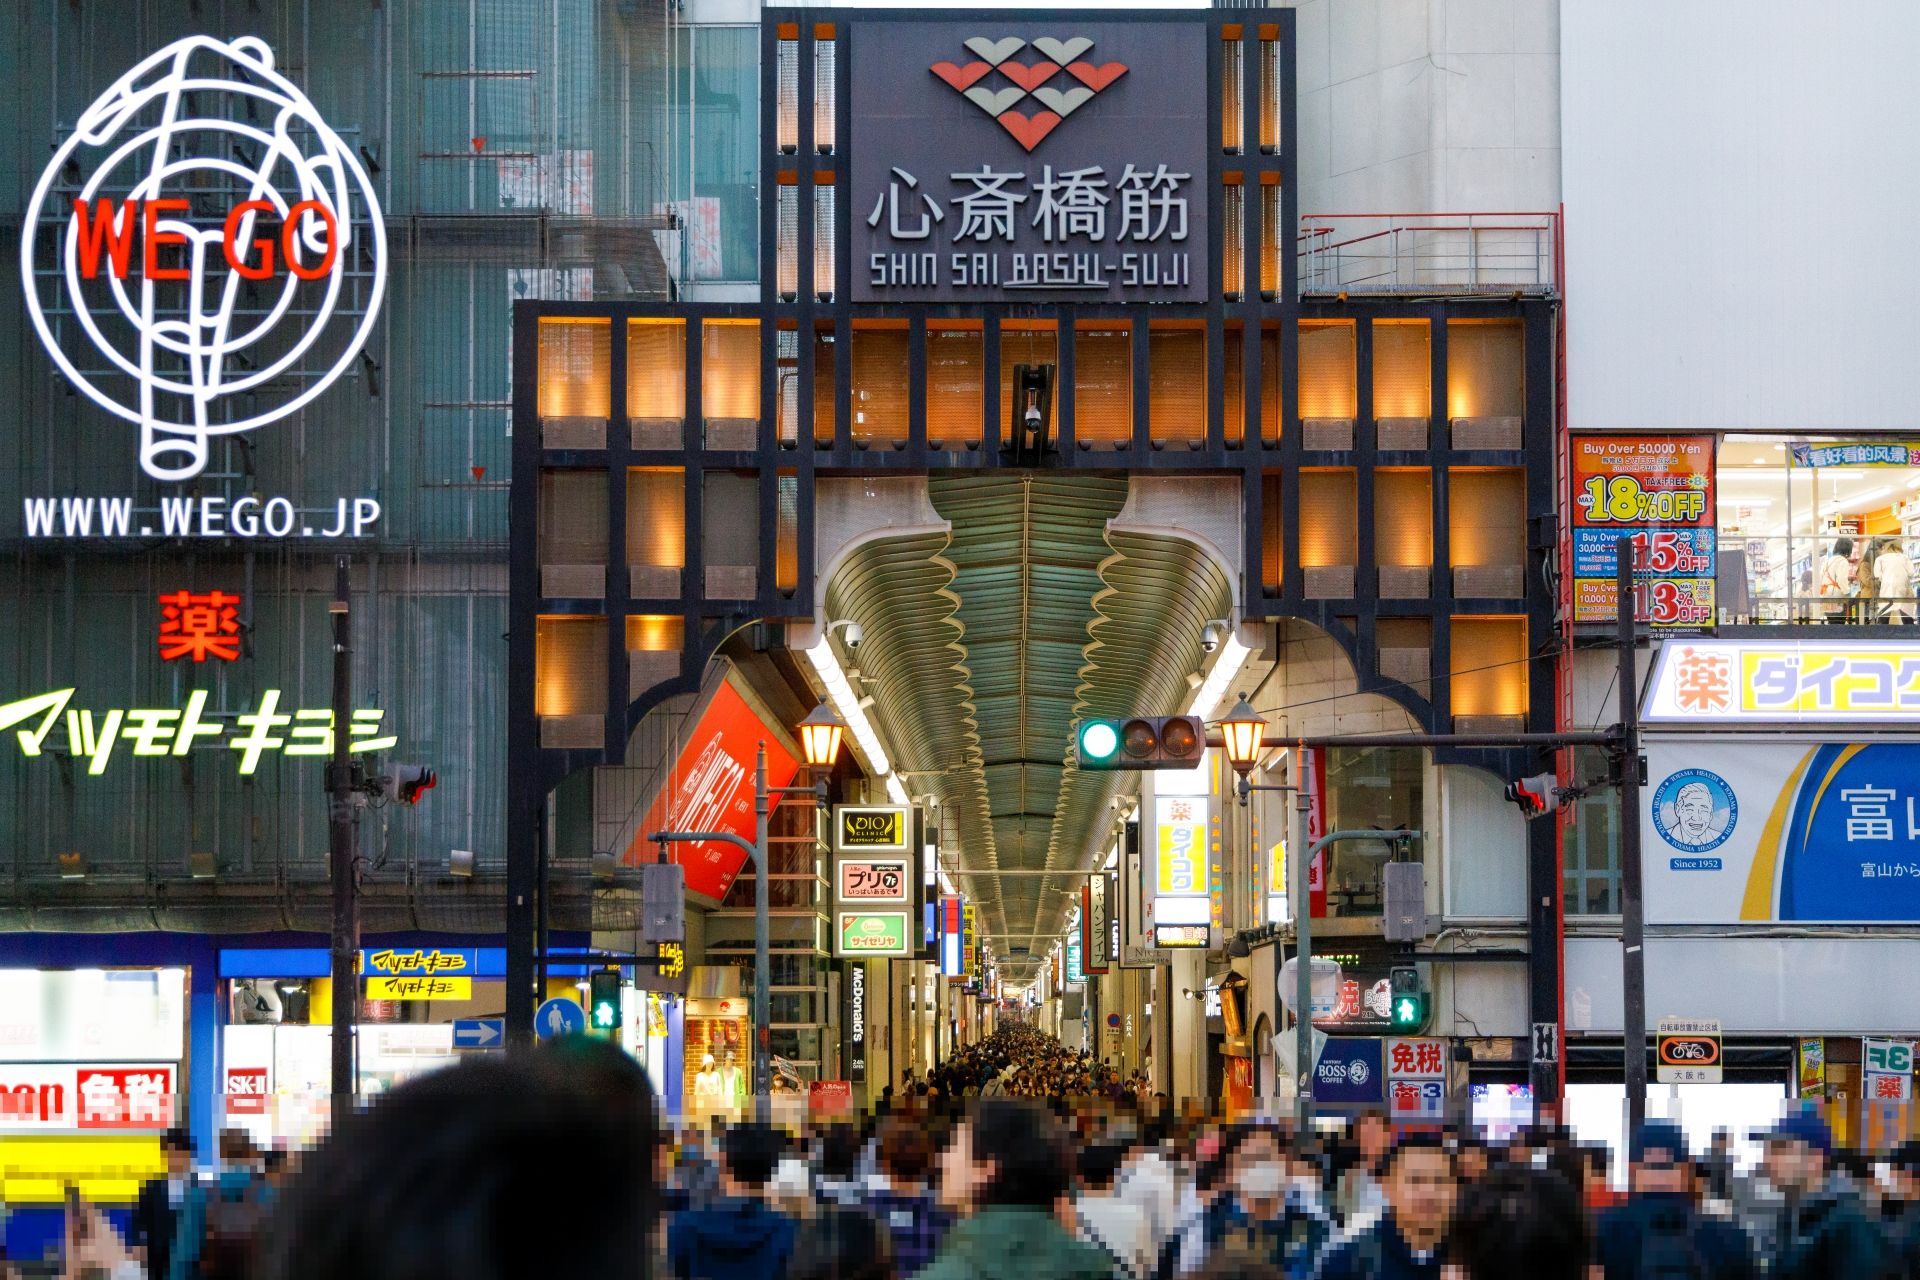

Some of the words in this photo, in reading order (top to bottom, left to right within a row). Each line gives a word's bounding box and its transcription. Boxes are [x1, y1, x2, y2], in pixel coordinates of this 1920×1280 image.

[867, 164, 1192, 243] 心斎橋筋
[871, 253, 937, 286] SHIN
[952, 253, 998, 286] SAI
[1583, 444, 1604, 455] Buy
[1608, 443, 1635, 454] Over
[1638, 444, 1676, 455] 50,000
[1680, 444, 1701, 454] Yen
[1809, 446, 1906, 466] 看好看的风景
[24, 497, 382, 537] WWW.WEGO.JP
[1582, 533, 1598, 543] Buy
[1583, 583, 1599, 593] Buy
[1600, 584, 1618, 592] Ove
[1608, 595, 1618, 603] Ye
[157, 590, 241, 662] 薬
[1677, 647, 1731, 711] 薬
[1696, 770, 1719, 783] HEALTH
[855, 817, 885, 830] DIO
[1674, 859, 1697, 868] Since
[1699, 860, 1719, 868] 1952
[849, 871, 881, 889] プリ
[885, 876, 897, 886] 7F
[372, 951, 465, 973] マツモトキヨシ
[384, 977, 456, 997] マツモトキヨシ
[852, 967, 864, 1043] McDonald's
[1391, 1042, 1443, 1074] 免税
[1318, 1064, 1347, 1077] BOSS
[1674, 1070, 1706, 1080] 大阪市
